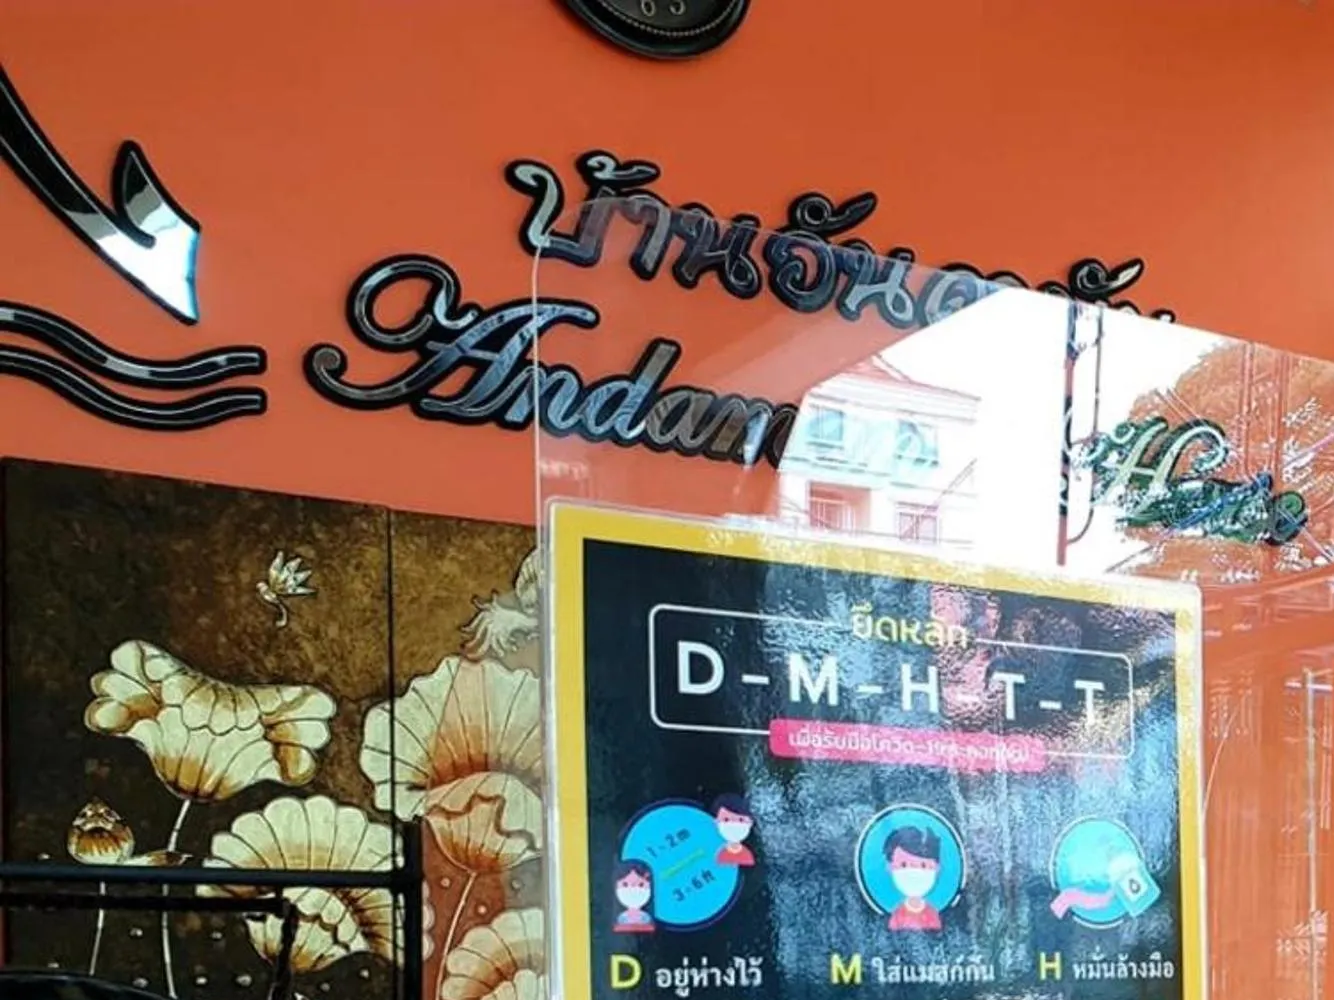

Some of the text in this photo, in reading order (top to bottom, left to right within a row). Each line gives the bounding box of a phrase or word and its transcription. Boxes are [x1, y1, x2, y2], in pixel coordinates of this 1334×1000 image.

[610, 954, 763, 998] D อยู่ห่างไว้
[831, 953, 862, 985] M
[1039, 945, 1175, 981] H หมั่นล้างมือ
